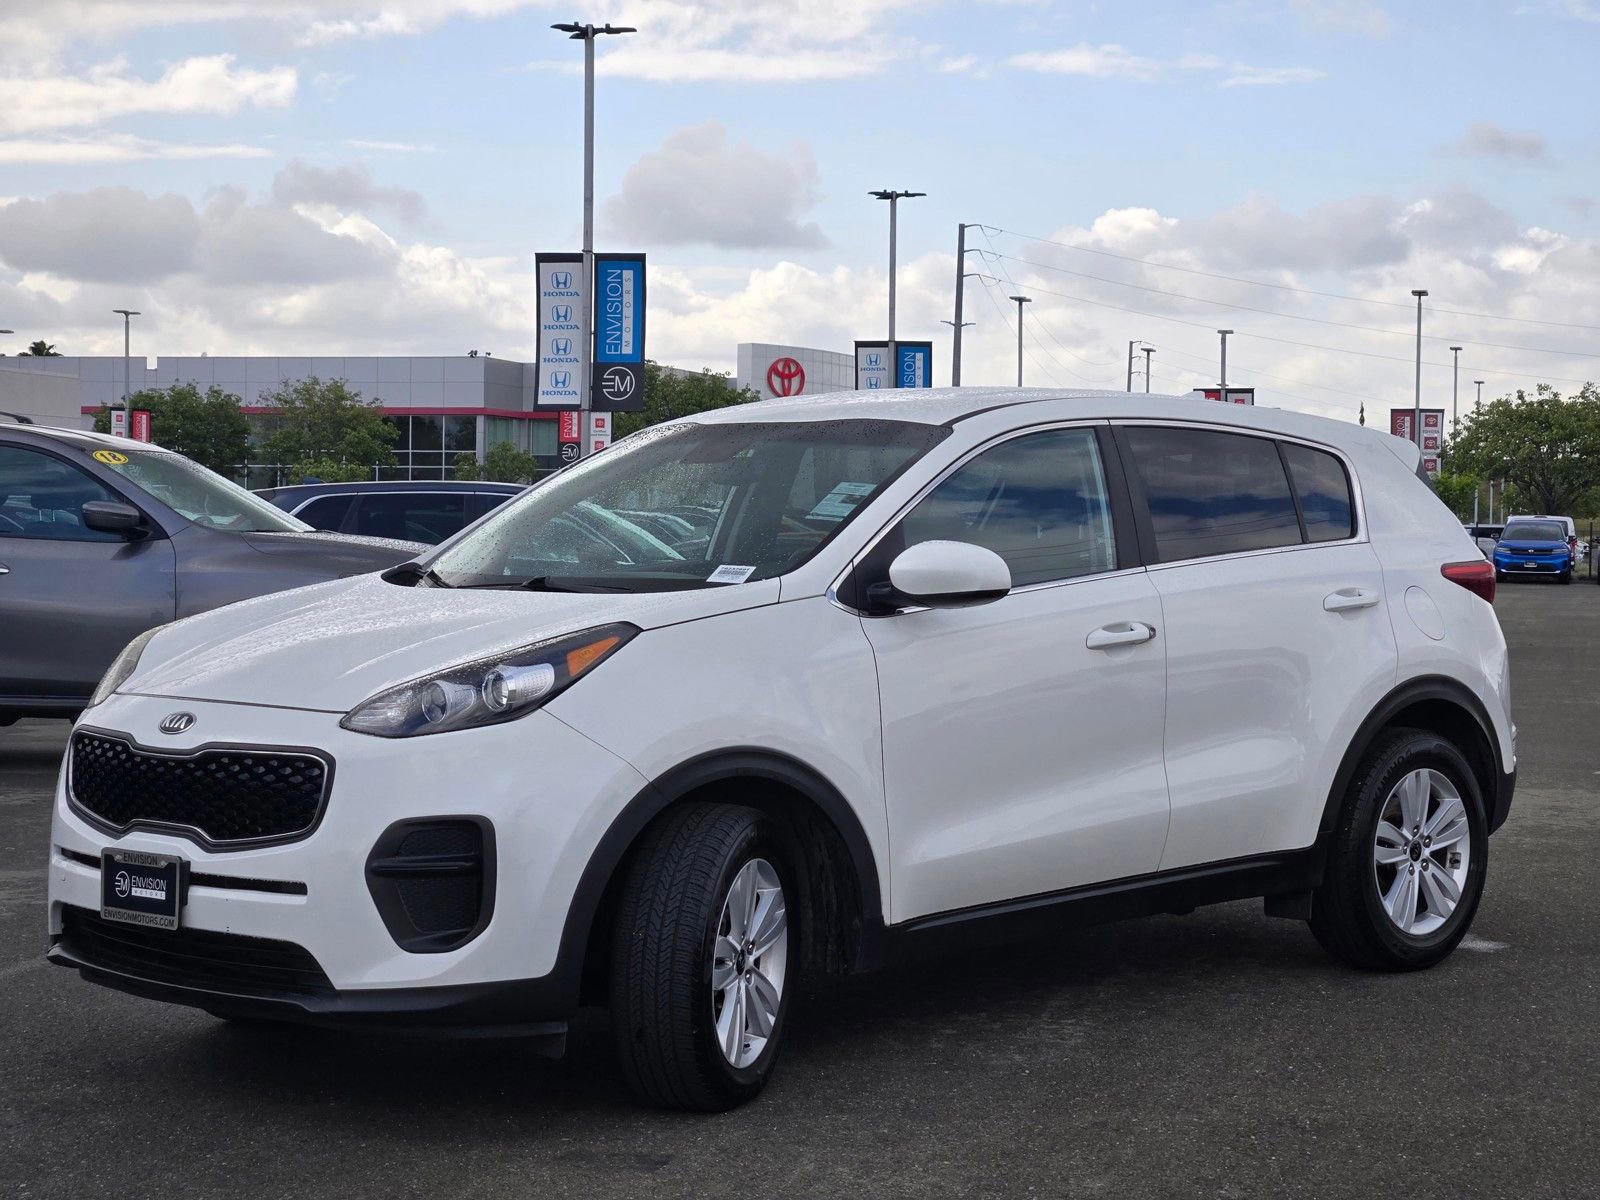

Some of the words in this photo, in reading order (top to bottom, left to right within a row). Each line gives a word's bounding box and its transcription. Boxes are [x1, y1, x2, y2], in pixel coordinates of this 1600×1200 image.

[606, 269, 622, 355] ENVISION
[624, 276, 632, 348] MOTORS
[904, 352, 914, 387] ISION
[161, 714, 191, 730] KIA
[123, 852, 158, 866] ENVISION
[131, 875, 167, 891] ENVISION
[103, 908, 175, 928] ENVISIONMOTORS.COM
